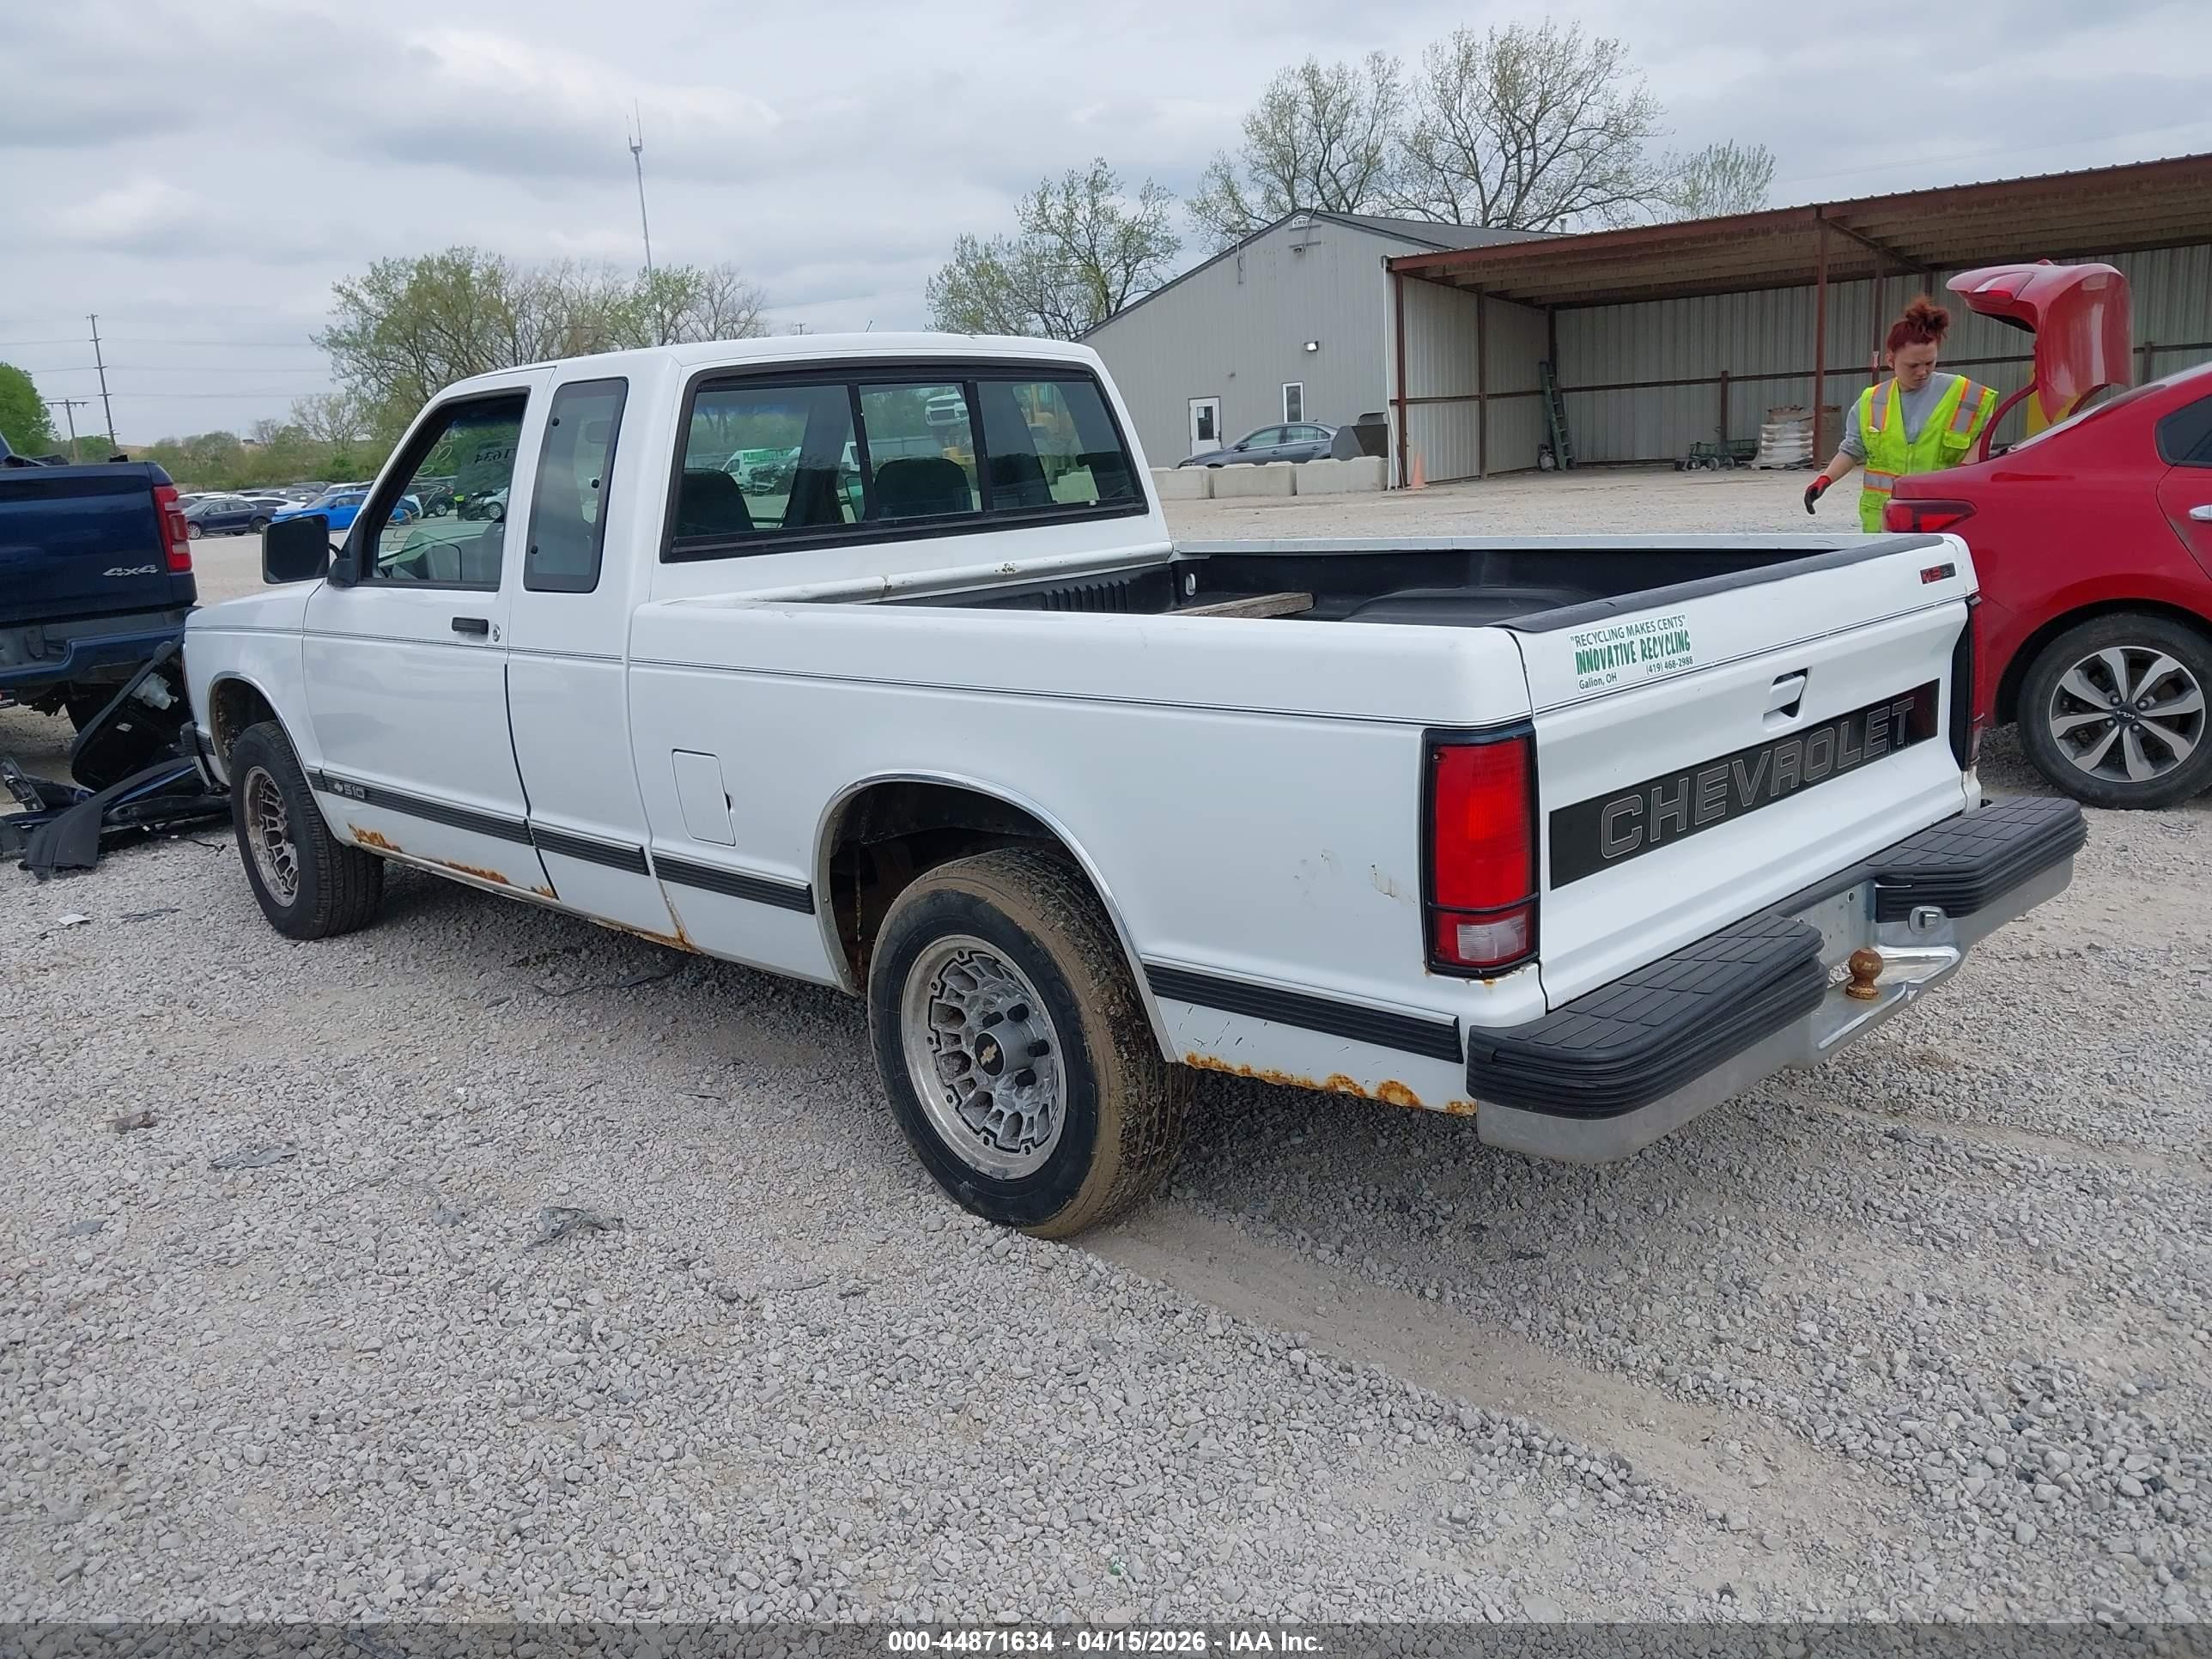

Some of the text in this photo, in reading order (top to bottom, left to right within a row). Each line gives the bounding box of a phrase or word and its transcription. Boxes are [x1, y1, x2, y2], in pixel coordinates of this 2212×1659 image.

[102, 564, 159, 576] 4x4
[1570, 615, 1686, 647] "RECYCLING MAKES CENTS"
[1575, 629, 1691, 675] INNOVATIVE RECYCLING
[1645, 655, 1693, 676] (419) 468-2988
[1578, 672, 1618, 690] Galion, OH
[1601, 697, 1914, 860] CHEVROLET
